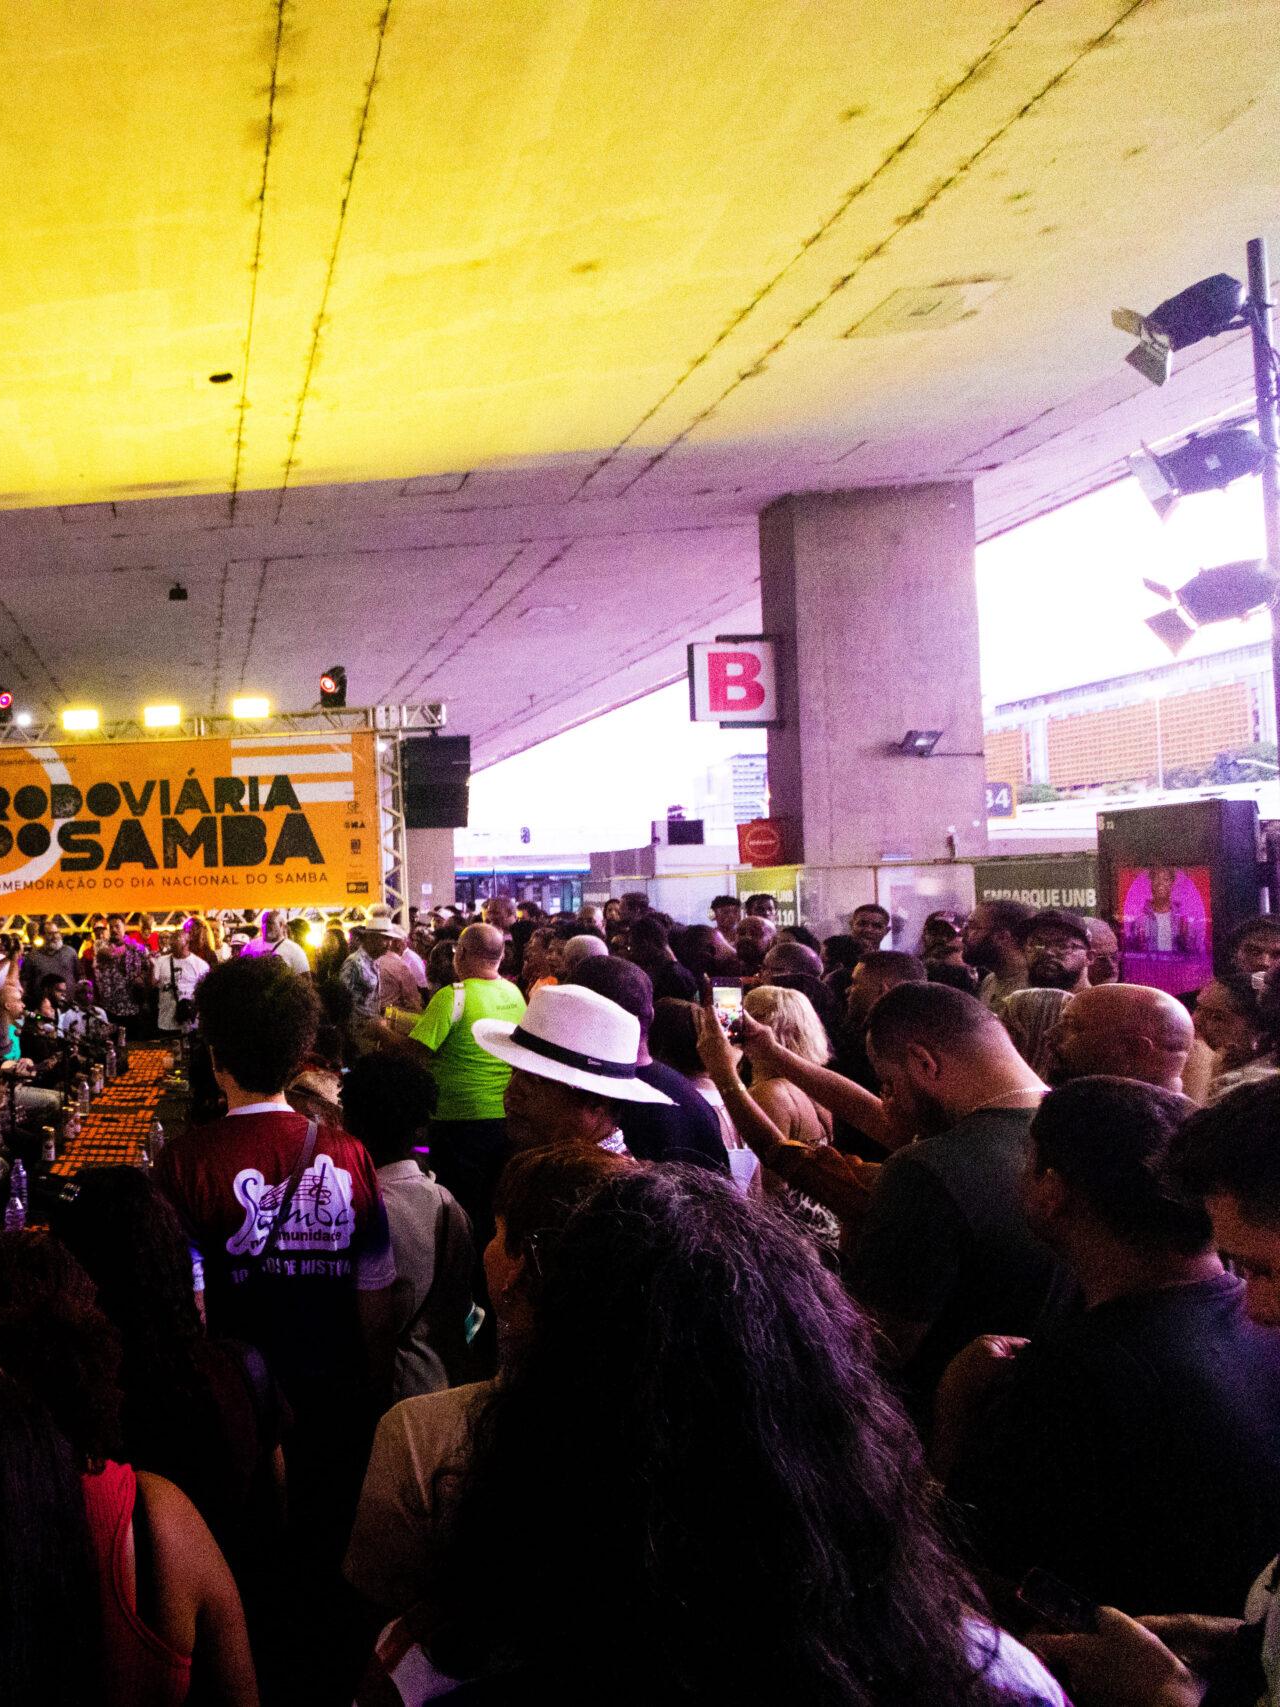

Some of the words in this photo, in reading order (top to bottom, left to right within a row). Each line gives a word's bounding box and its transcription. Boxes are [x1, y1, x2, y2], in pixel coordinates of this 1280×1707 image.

[708, 652, 765, 712] B
[57, 813, 325, 872] SAMBA
[103, 877, 124, 889] DO
[130, 875, 155, 888] DIA
[162, 874, 238, 887] NACIONAL
[246, 873, 268, 885] DO
[275, 872, 328, 885] SAMBA
[1061, 888, 1097, 907] UNB
